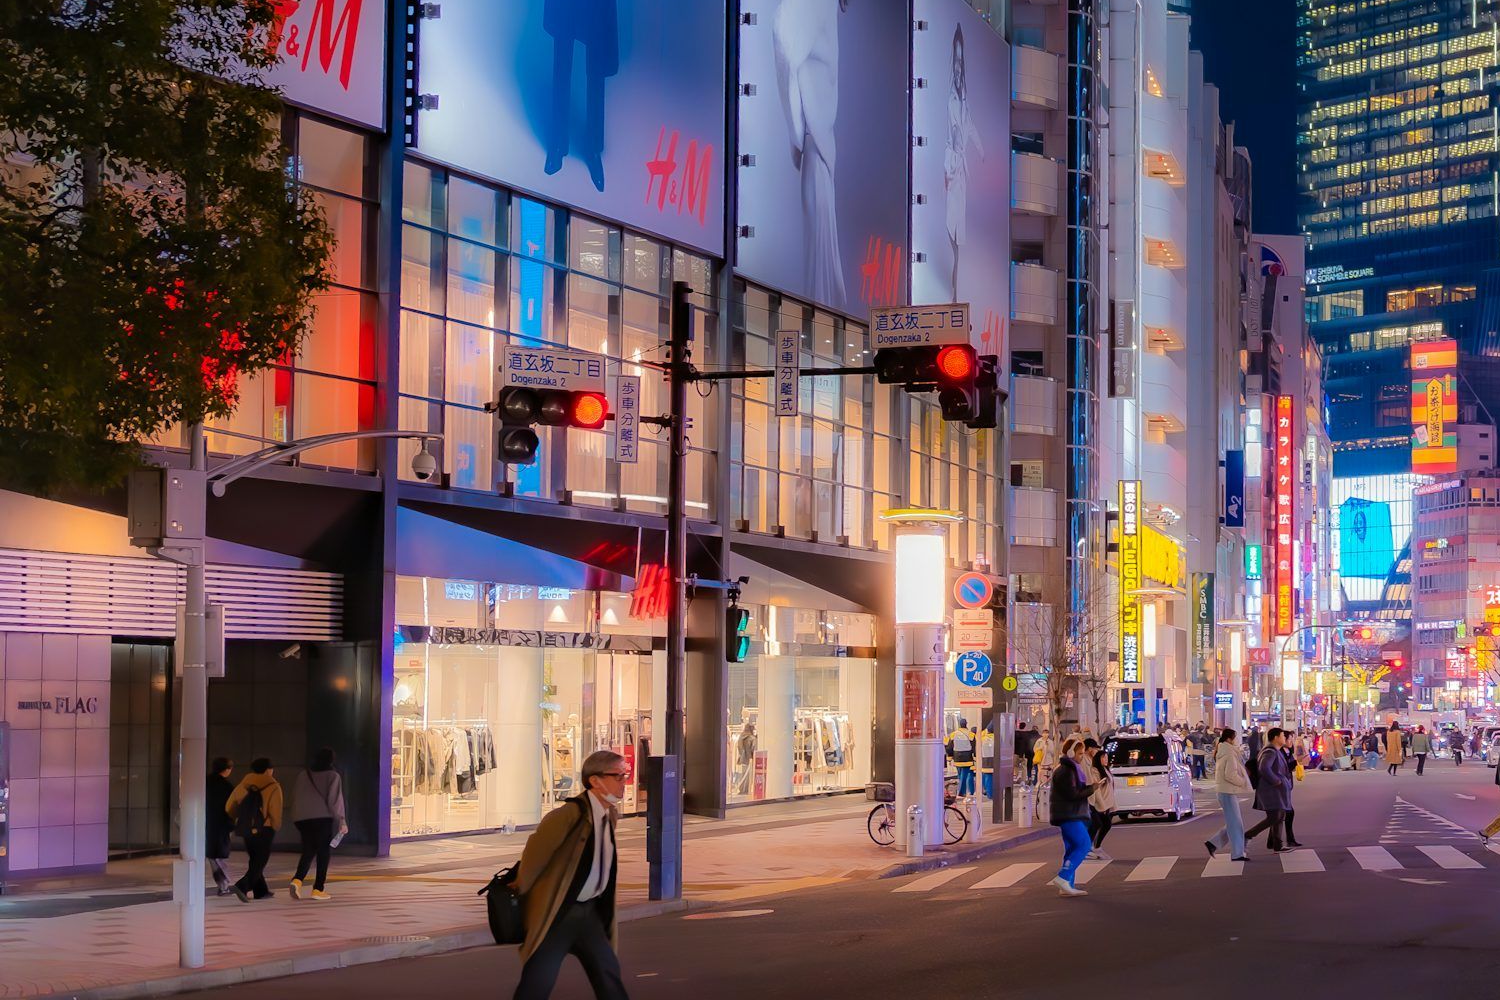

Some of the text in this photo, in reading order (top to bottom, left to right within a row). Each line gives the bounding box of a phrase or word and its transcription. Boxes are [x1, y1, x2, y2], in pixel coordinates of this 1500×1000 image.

[645, 124, 713, 227] H&M
[860, 234, 902, 307] H&M
[1317, 265, 1344, 275] SHIBUYA
[1317, 267, 1374, 283] SCRAMBLE SQUARE
[875, 310, 964, 332] 道玄坂二丁目
[877, 333, 930, 345] Dogenzaka 2
[508, 352, 600, 377] 道玄坂二丁目
[780, 336, 794, 411] 歩車分離式
[511, 374, 566, 387] Dogenzaka 2
[620, 382, 635, 458] 歩車分離式
[1279, 416, 1290, 546] カラオケ歌広場
[1199, 589, 1208, 619] SMBC
[962, 658, 984, 682] P 40
[55, 696, 97, 714] FLAG
